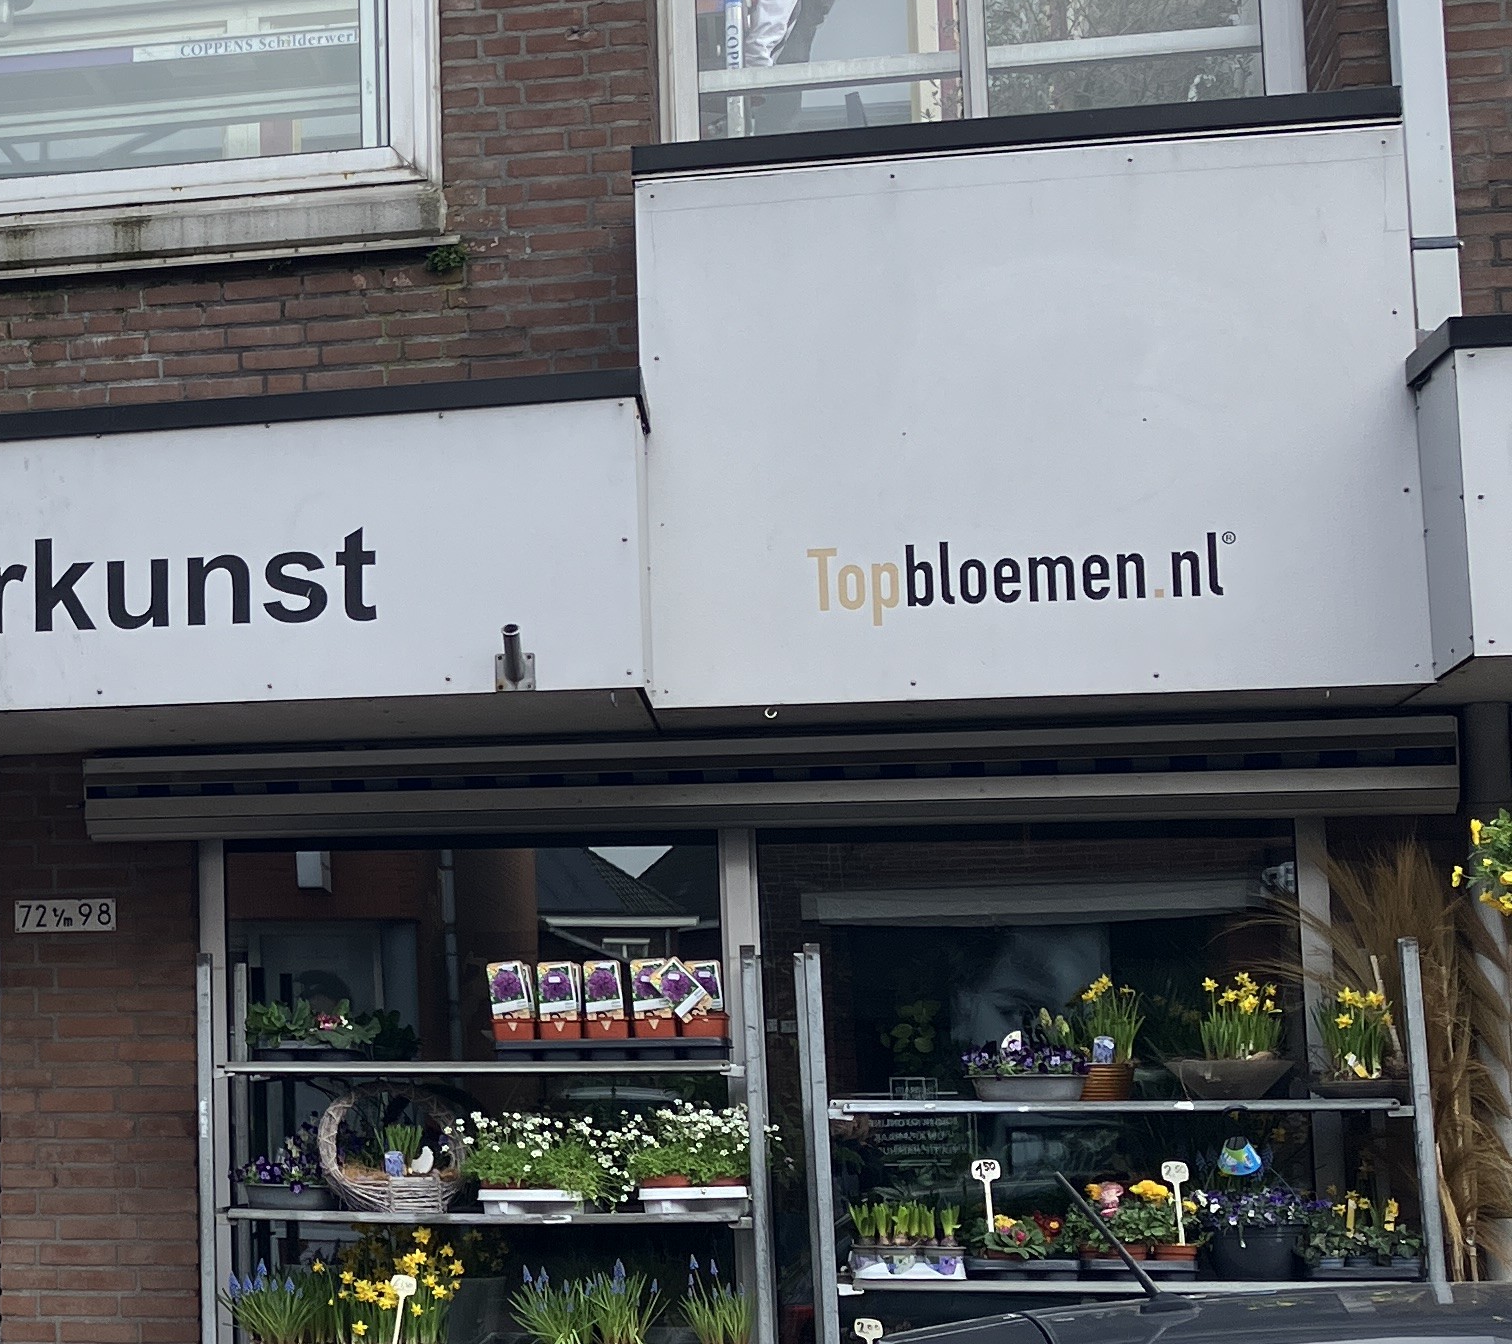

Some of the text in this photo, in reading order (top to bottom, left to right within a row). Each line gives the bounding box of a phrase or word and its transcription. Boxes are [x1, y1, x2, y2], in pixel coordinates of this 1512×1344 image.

[180, 39, 254, 58] COPPENS
[18, 903, 47, 928] 72
[78, 902, 112, 926] 98
